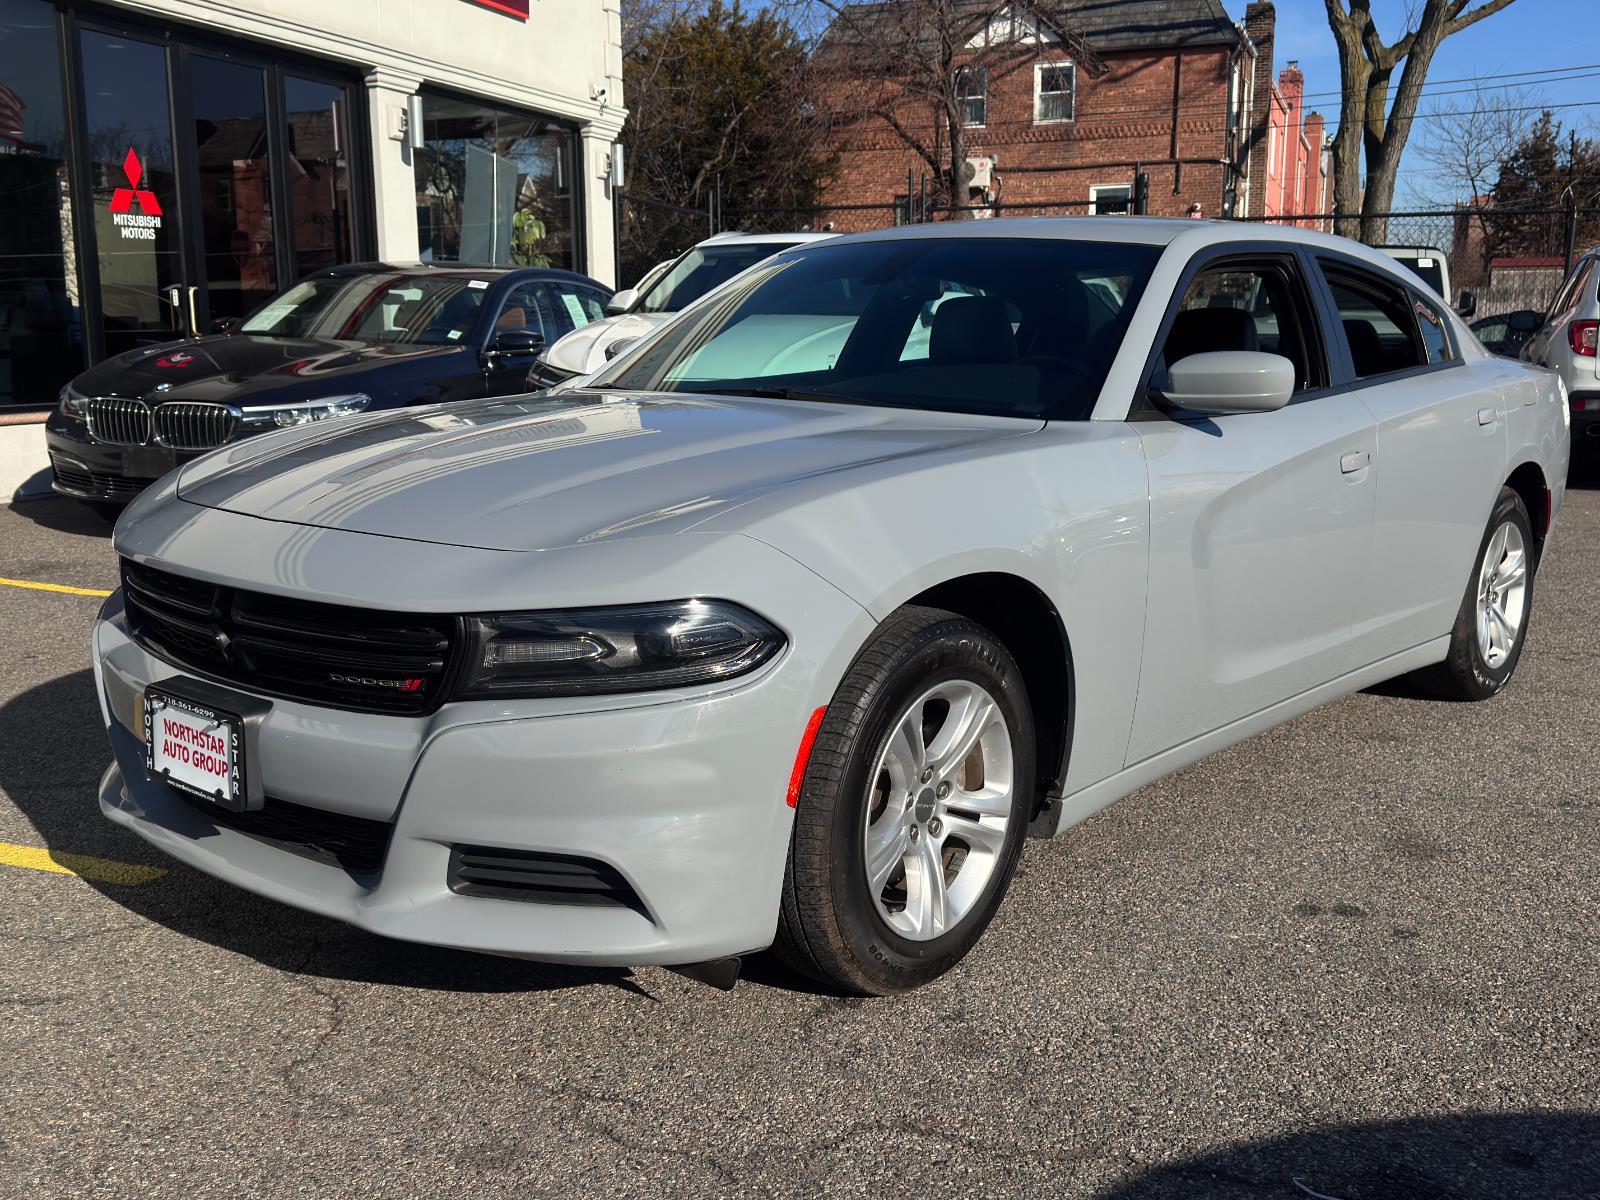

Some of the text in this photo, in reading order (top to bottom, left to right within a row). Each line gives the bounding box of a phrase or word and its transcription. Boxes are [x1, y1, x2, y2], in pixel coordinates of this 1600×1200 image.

[113, 213, 161, 228] MITSUBISHI
[121, 227, 156, 240] MOTORS
[329, 673, 408, 688] DODGE
[162, 695, 215, 719] 718-361-6299
[144, 699, 153, 770] NORTH
[163, 718, 226, 756] NORTHSTAR
[162, 739, 229, 778] AUTO GROUP
[231, 733, 240, 796] STAR
